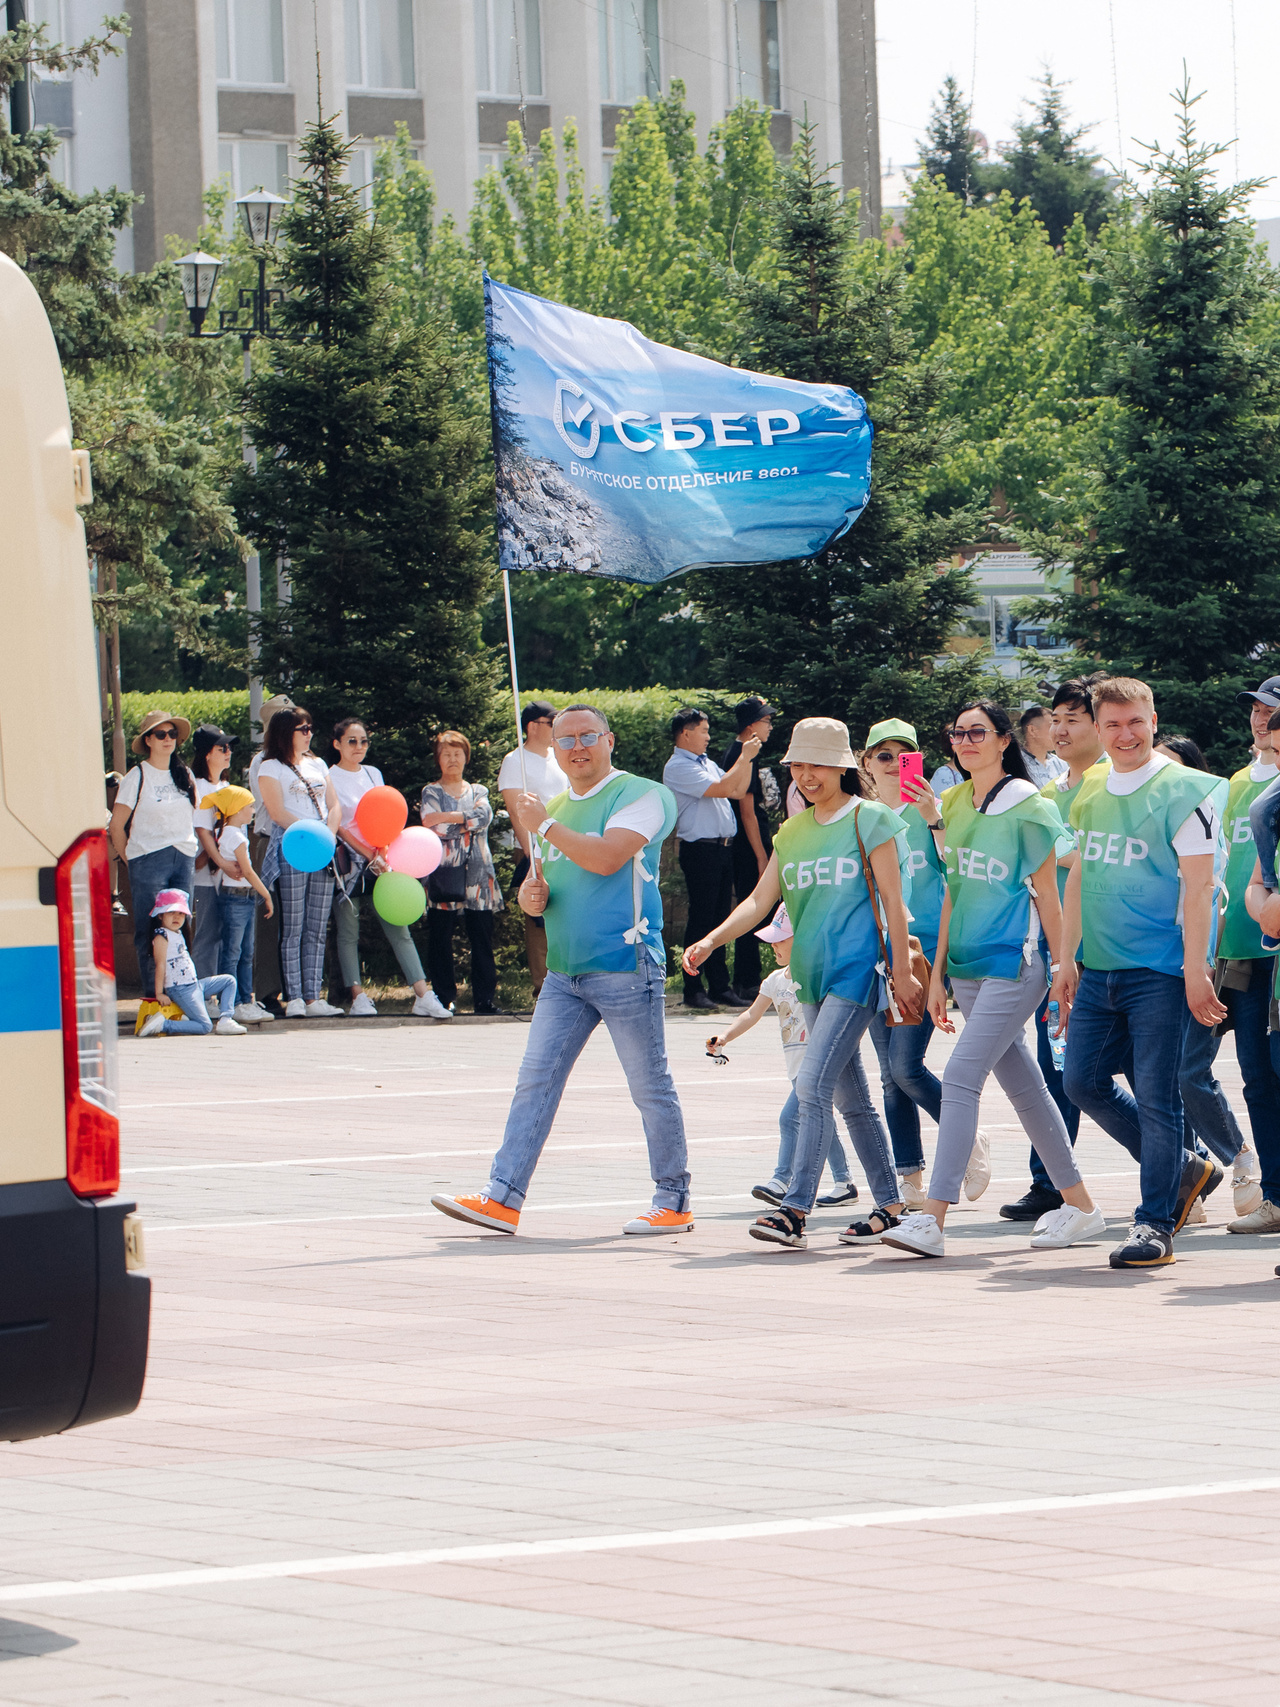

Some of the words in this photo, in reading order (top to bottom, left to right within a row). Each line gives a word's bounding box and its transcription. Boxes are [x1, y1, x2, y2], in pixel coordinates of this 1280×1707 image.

[612, 409, 801, 452] СБЕР
[570, 461, 643, 490] БУРЯТСКОЕ
[646, 470, 753, 493] ОТДЕЛЕНИЕ
[758, 466, 800, 480] 8601
[781, 856, 859, 891] СБЕР
